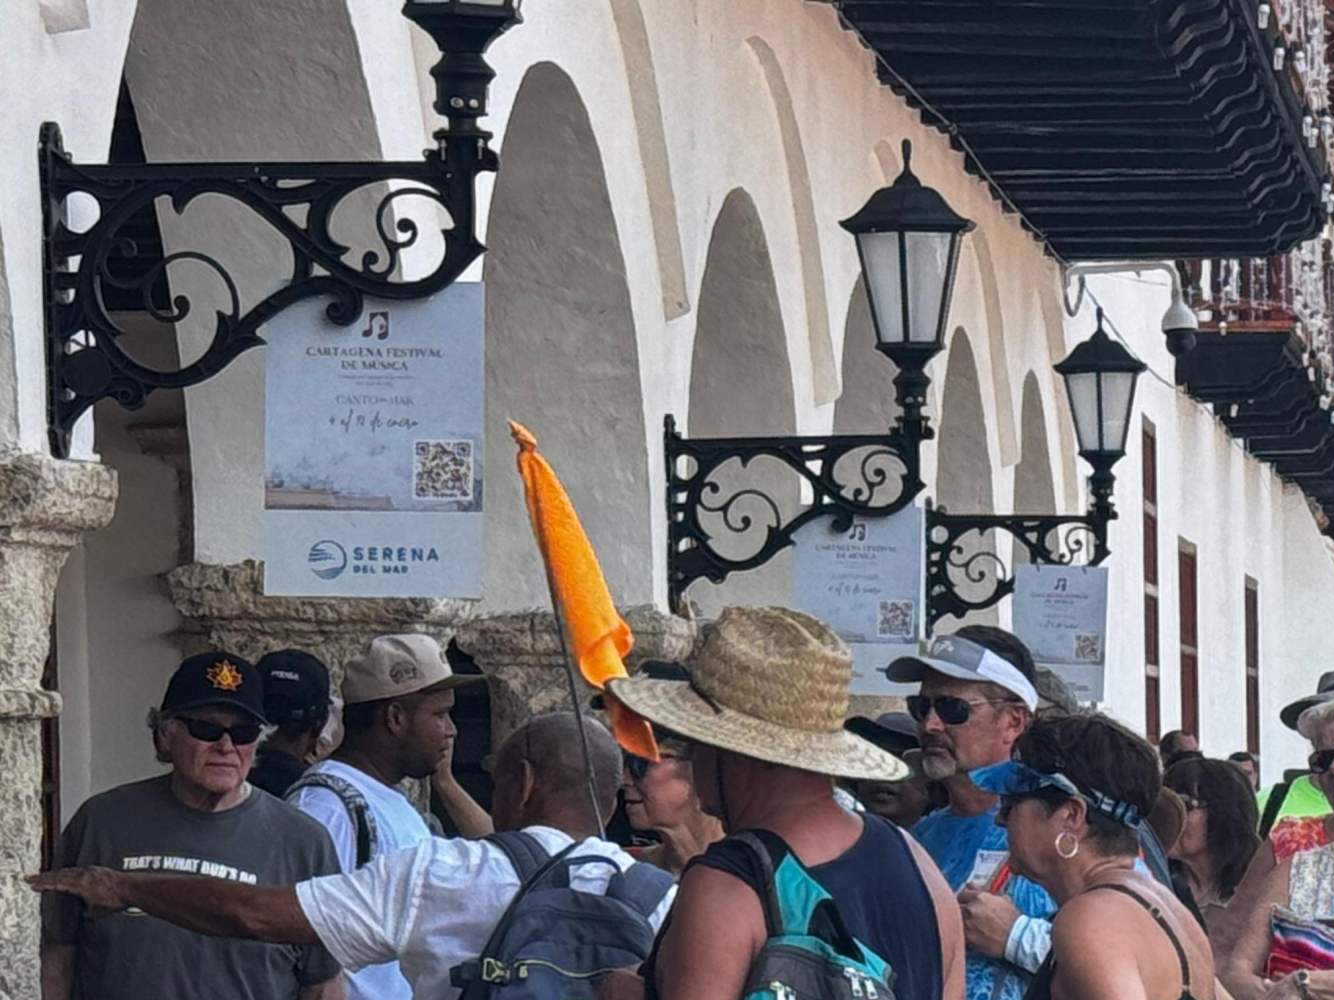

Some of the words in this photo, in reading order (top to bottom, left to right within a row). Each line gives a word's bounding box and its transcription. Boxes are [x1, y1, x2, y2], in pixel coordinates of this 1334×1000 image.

[305, 345, 383, 358] CARTAGENA
[385, 346, 443, 358] FESTIVAL
[341, 360, 358, 371] DE
[353, 546, 440, 562] SERENA
[353, 564, 377, 575] DEL
[122, 855, 162, 870] THAT'S
[162, 856, 201, 873] WHAT
